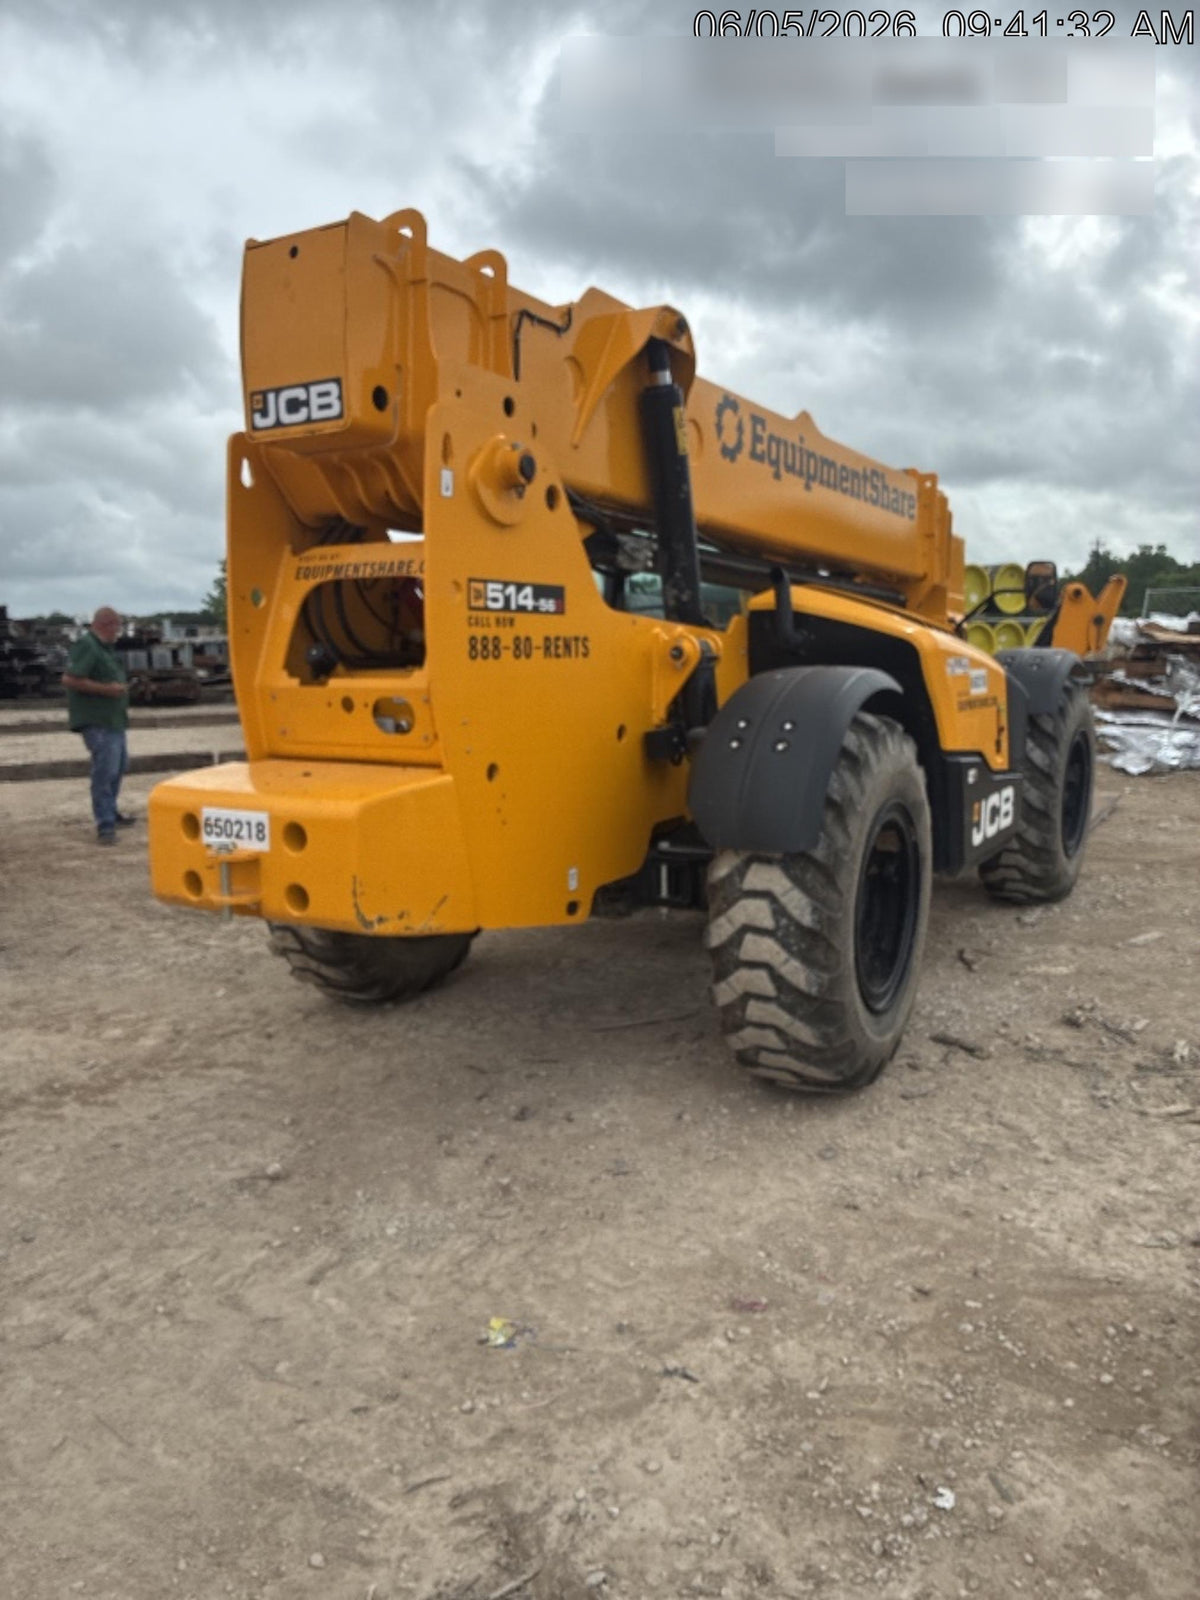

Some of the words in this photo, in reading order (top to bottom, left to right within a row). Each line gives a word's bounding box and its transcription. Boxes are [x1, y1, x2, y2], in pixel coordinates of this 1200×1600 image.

[252, 381, 341, 429] JCB
[749, 413, 916, 521] EquipmentShare
[468, 616, 491, 628] CALL
[495, 616, 515, 628] NOW
[468, 635, 590, 661] 888-80-RENTS
[203, 816, 267, 843] 650218
[972, 785, 1015, 847] JCB
